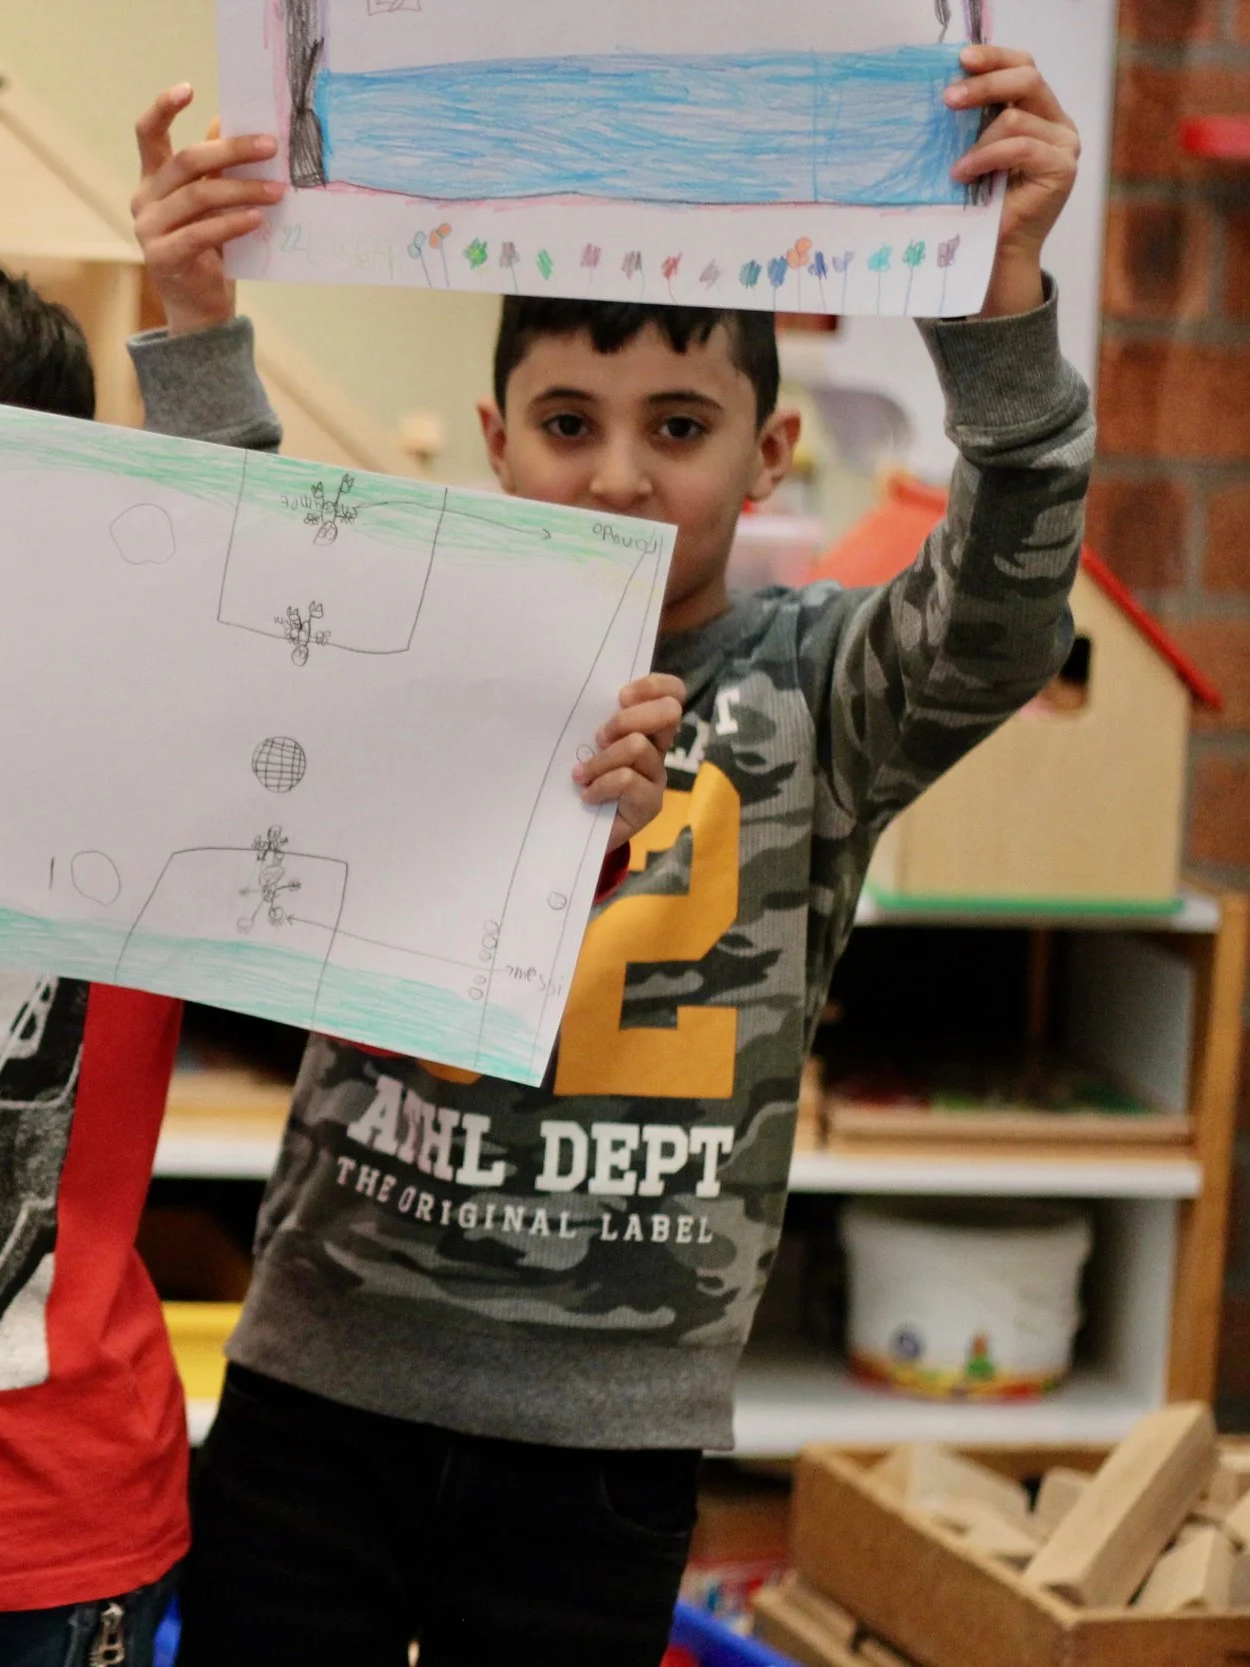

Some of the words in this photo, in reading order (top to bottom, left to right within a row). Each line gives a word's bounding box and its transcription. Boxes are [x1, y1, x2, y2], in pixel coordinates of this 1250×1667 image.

[346, 1073, 508, 1189] ATHL
[534, 1119, 736, 1199] DEPT
[335, 1155, 398, 1204] THE
[397, 1178, 578, 1240] ORIGINAL
[600, 1212, 715, 1245] LABEL
